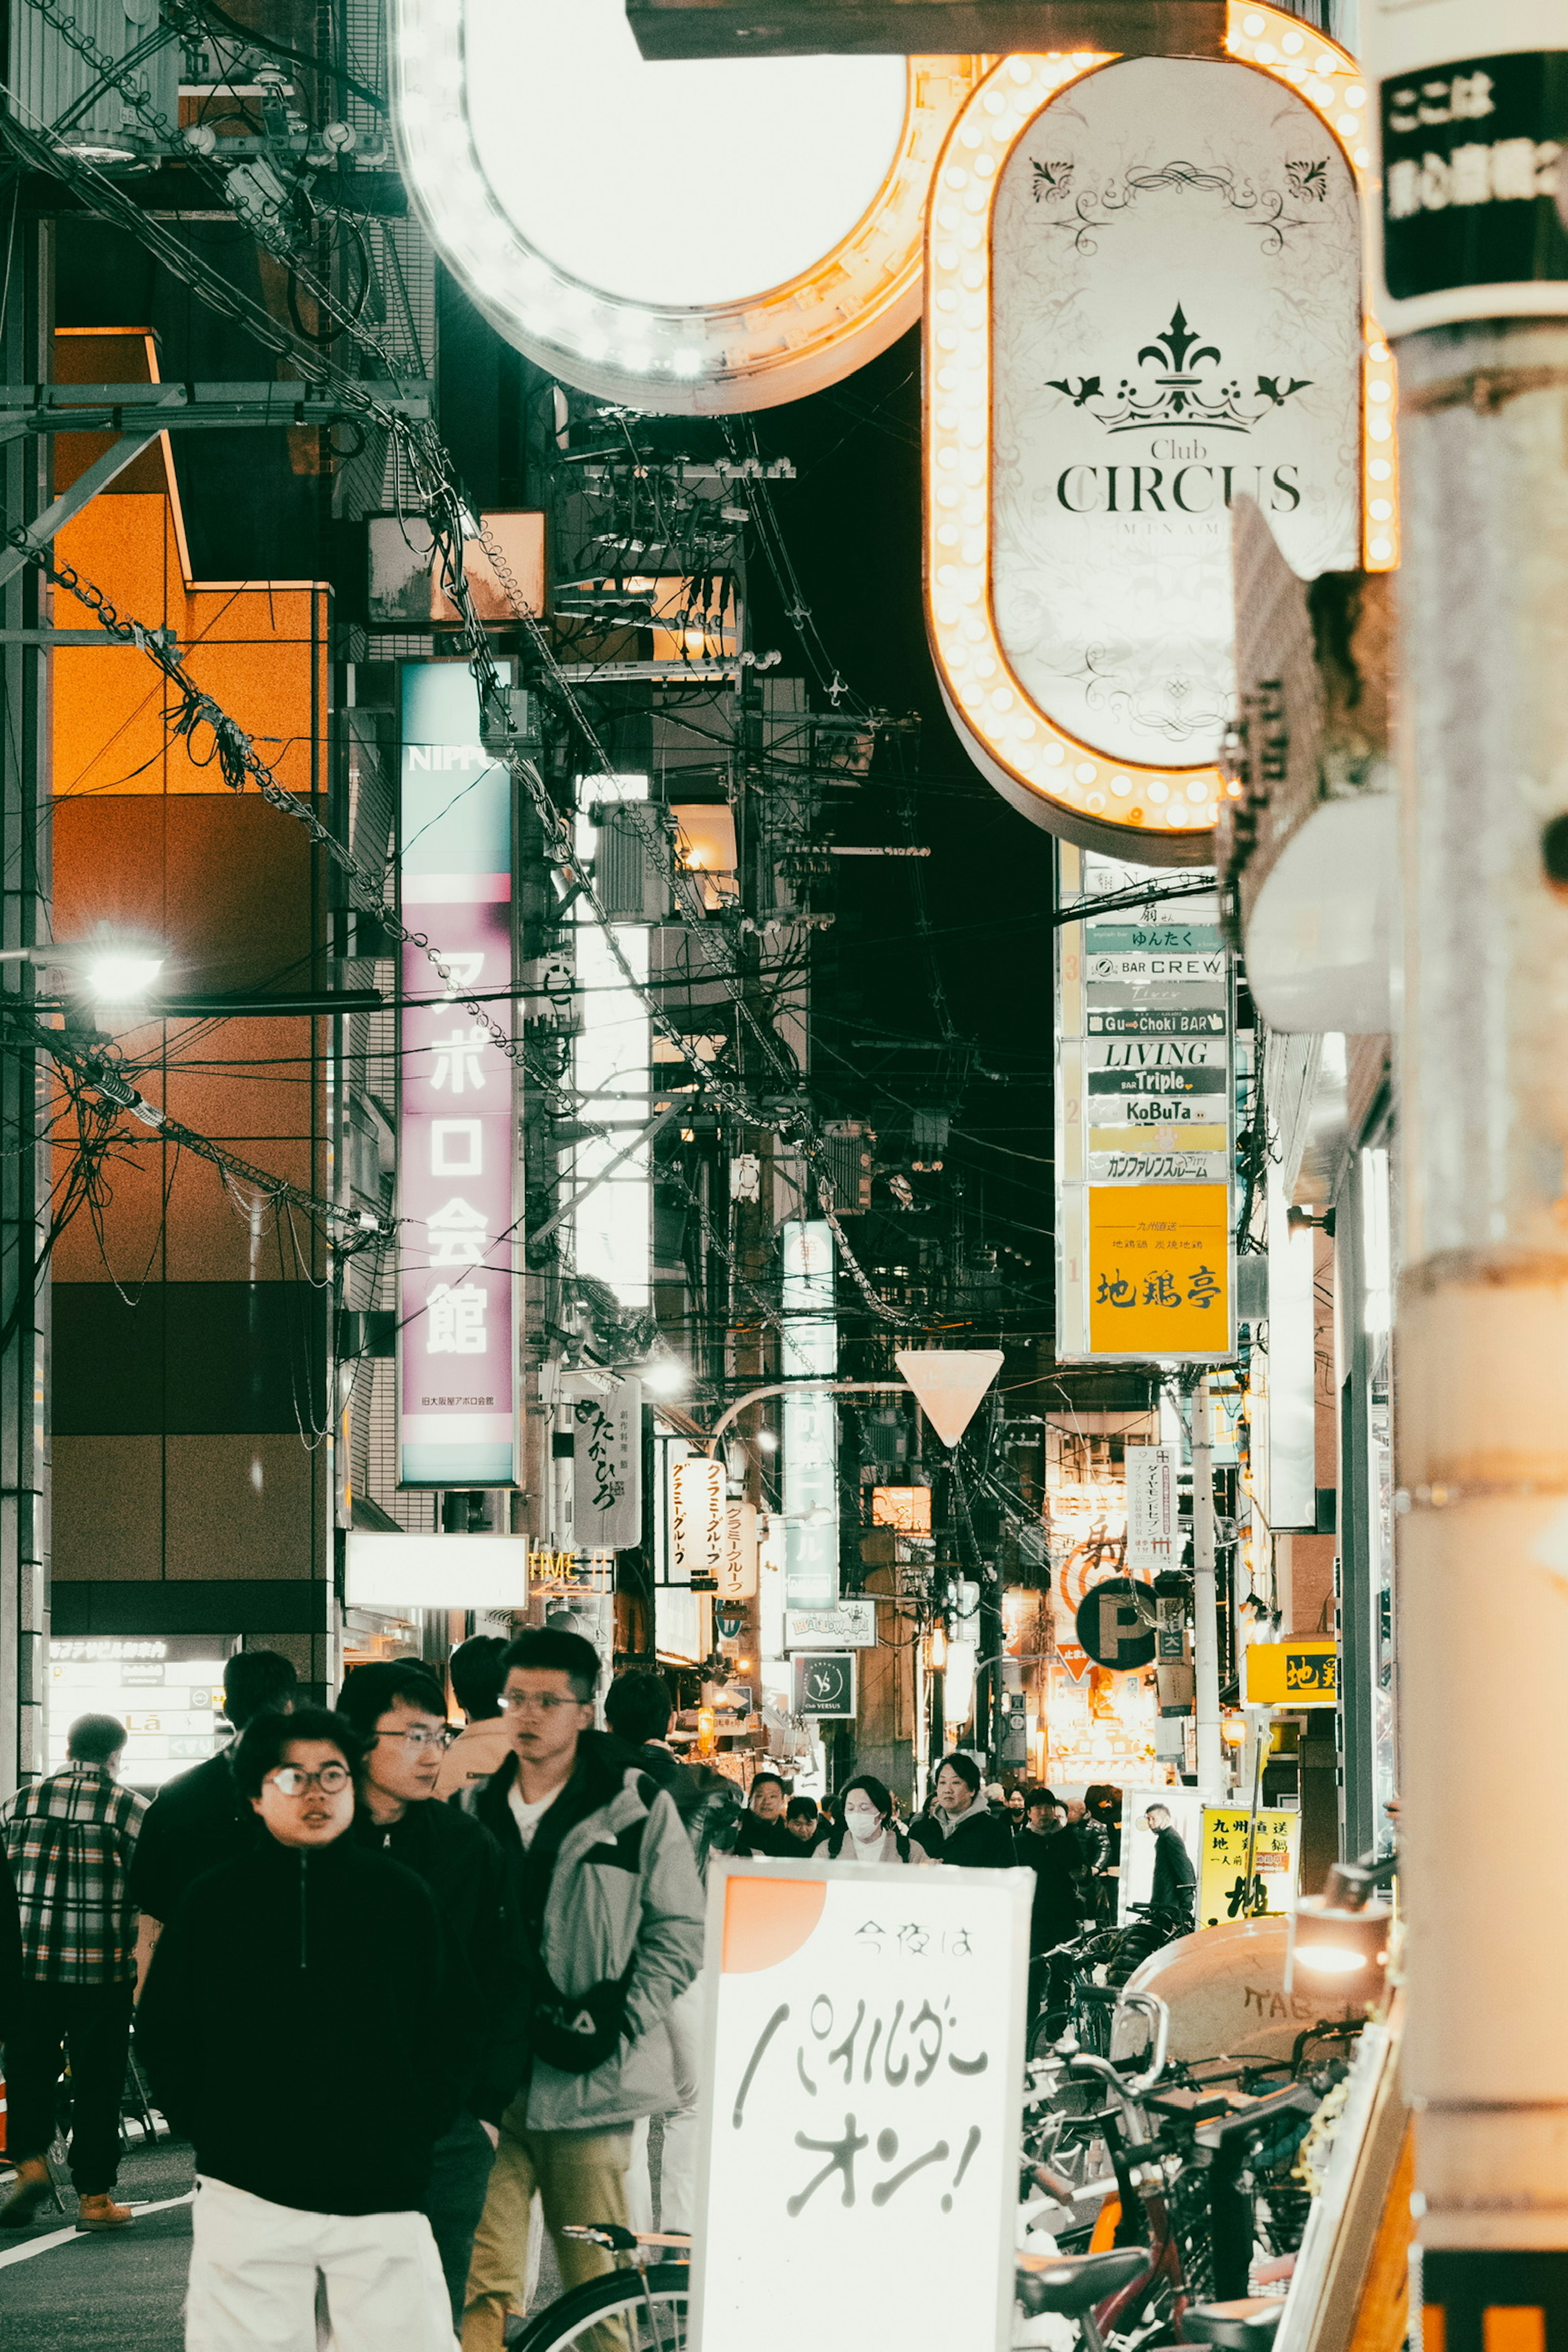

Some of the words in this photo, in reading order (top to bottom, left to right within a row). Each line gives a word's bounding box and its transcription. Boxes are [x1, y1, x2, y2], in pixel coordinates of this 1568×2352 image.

[1151, 439, 1207, 459] Club
[1057, 465, 1300, 512] CIRCUS
[1124, 523, 1219, 535] MINAM
[1133, 931, 1192, 946] ゆんたく
[1066, 955, 1079, 980] 3
[1123, 962, 1146, 972] BAR
[1152, 961, 1221, 973] CREW
[1105, 1017, 1125, 1031] Gu
[1140, 1017, 1176, 1031] Choki
[1180, 1017, 1207, 1030] BAR
[1104, 1042, 1207, 1066] LIVING
[1135, 1071, 1184, 1093] Triple
[1066, 1100, 1079, 1124] 2
[1127, 1102, 1190, 1119] KoBuTa
[426, 953, 490, 1354] アポロ会館
[1137, 1222, 1177, 1231] 九州直送
[1096, 1265, 1222, 1309] 地鶏亭
[421, 1396, 494, 1406] 旧大阪屋アポロ会館
[588, 1411, 615, 1512] たかひろ
[673, 1463, 691, 1564] グラミーグループ
[706, 1463, 724, 1564] グラミーグループ
[1212, 1819, 1288, 1837] 九州直送
[1211, 1855, 1242, 1865] 一人前
[854, 1920, 973, 1956] 今夜は
[733, 1993, 988, 2129] パイルダー
